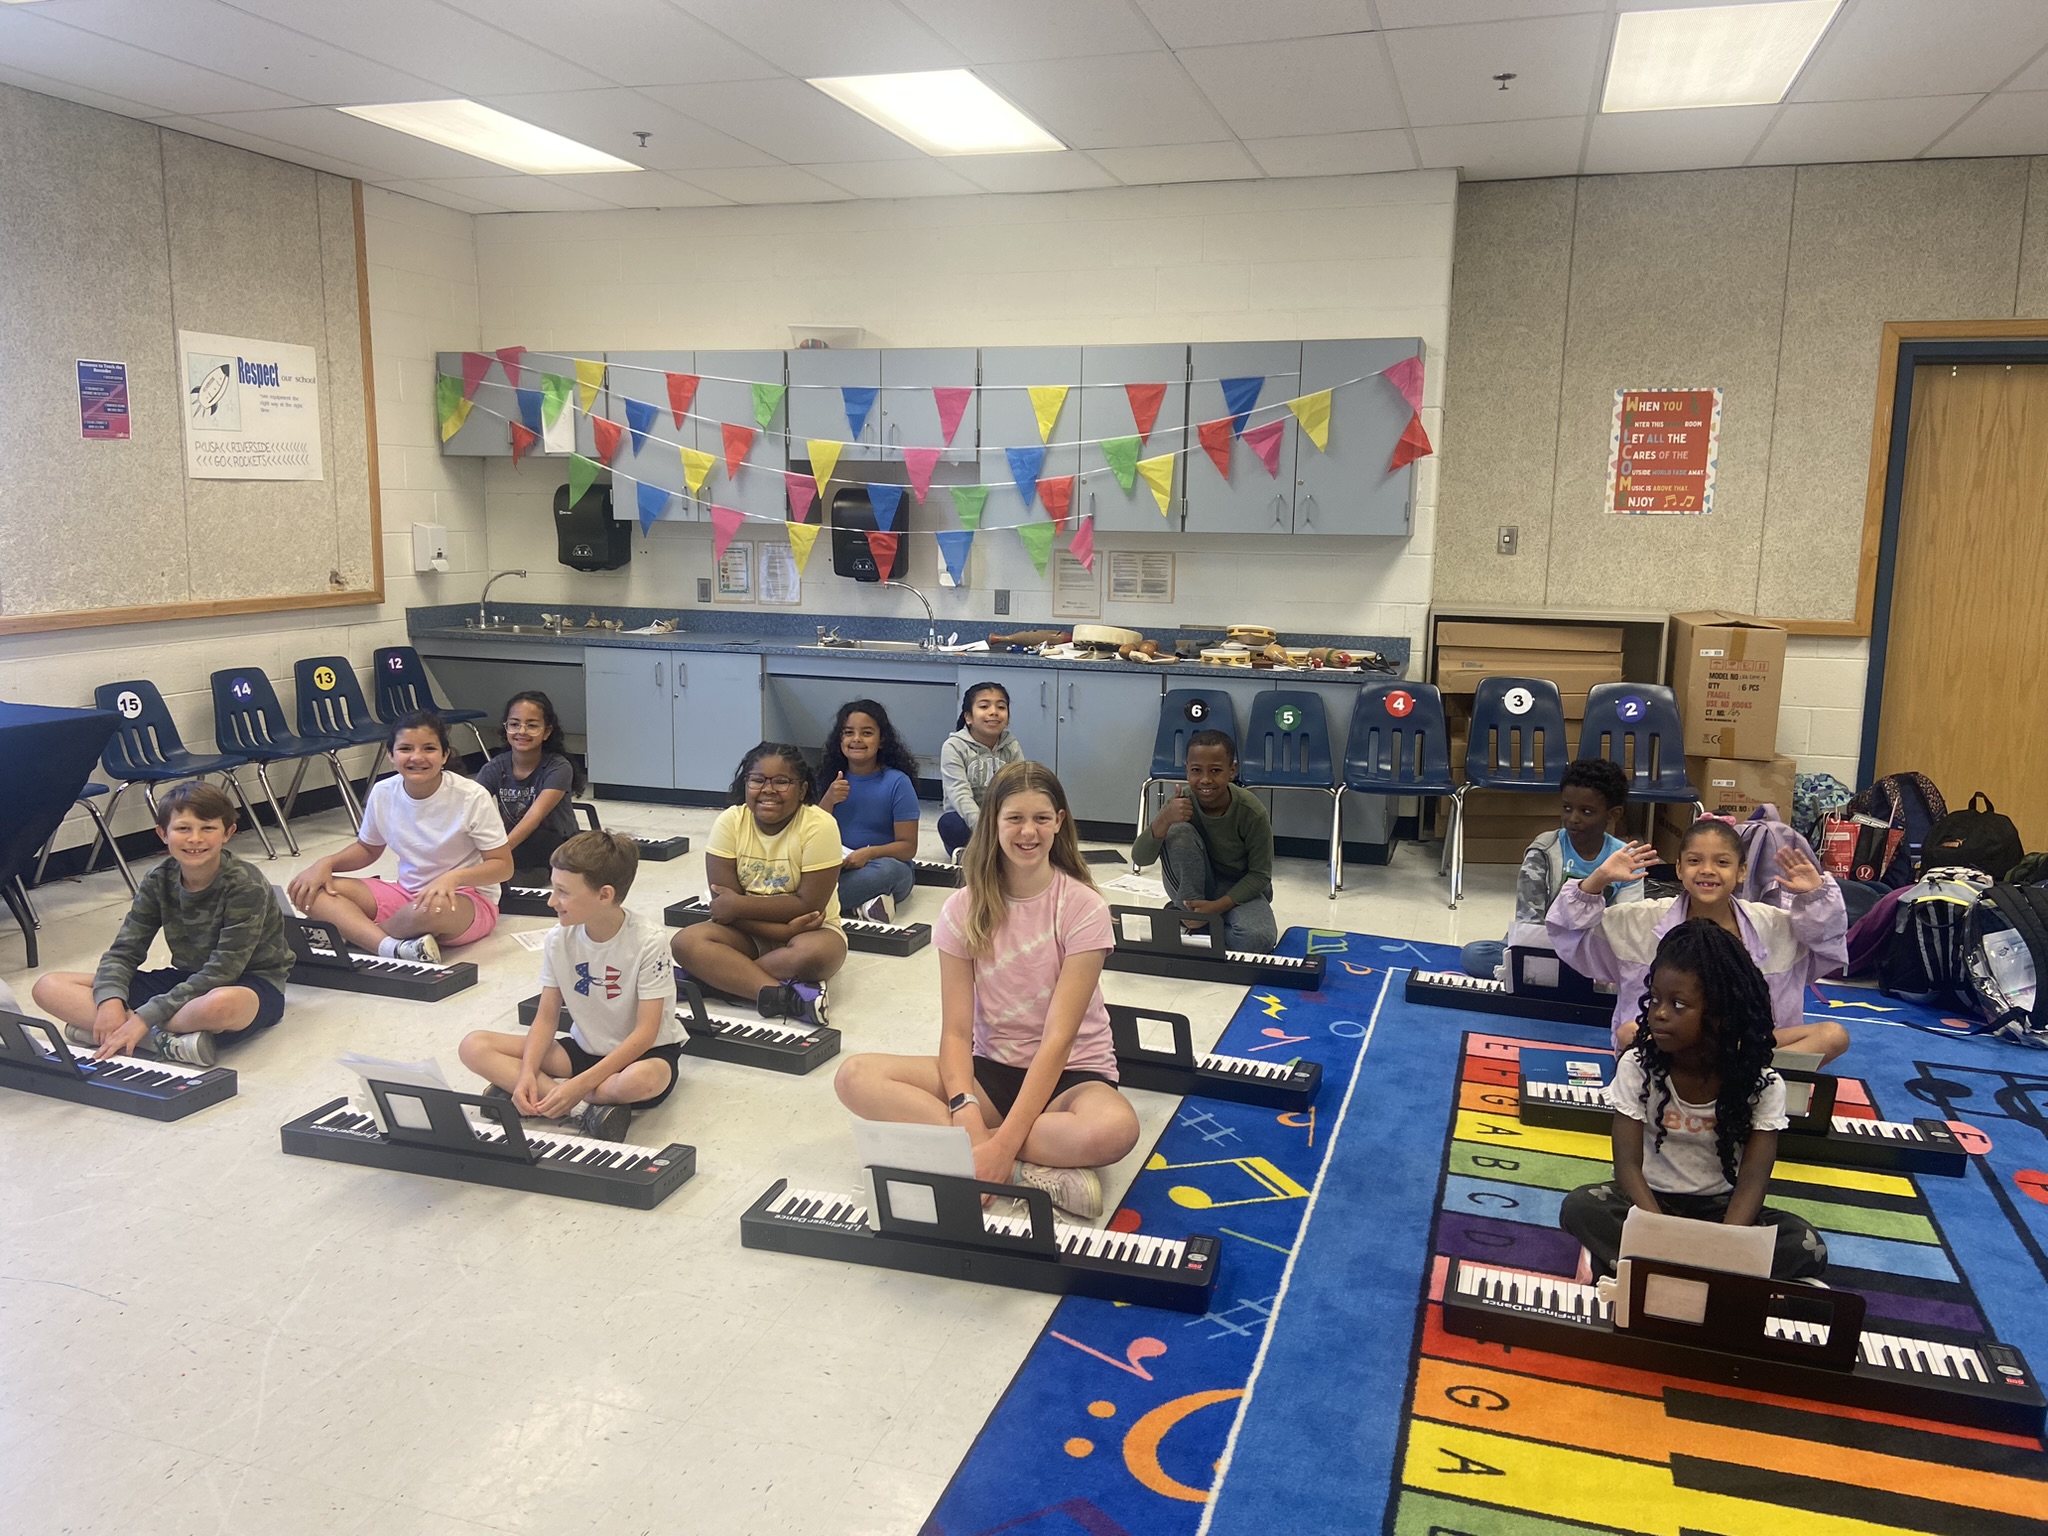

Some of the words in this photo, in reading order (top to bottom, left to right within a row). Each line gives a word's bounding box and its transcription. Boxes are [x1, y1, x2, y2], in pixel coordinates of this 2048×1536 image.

[237, 356, 280, 388] Respect
[295, 375, 316, 384] school
[1626, 396, 1660, 412] WHEN
[1663, 401, 1683, 412] YOU
[1624, 429, 1644, 444] LET
[1646, 434, 1664, 444] ALL
[1668, 434, 1686, 444] THE
[1622, 444, 1656, 460] CARES
[1658, 451, 1670, 460] OF
[1672, 451, 1688, 460] THE
[1620, 476, 1644, 491] MUSIC
[388, 658, 403, 669] 12
[316, 672, 333, 684] 13
[1709, 672, 1728, 680] MODEL
[234, 682, 251, 698] 14
[1706, 691, 1730, 699] FRAGILE
[120, 698, 138, 711] 15
[1392, 697, 1405, 710] 4
[1513, 694, 1524, 707] 3
[1706, 700, 1718, 708] USE
[1720, 700, 1730, 708] NO
[1732, 701, 1752, 709] HOOKS
[1191, 704, 1202, 718] 6
[1624, 702, 1638, 716] 2
[1283, 711, 1294, 724] 5
[1718, 804, 1738, 812] MODEL
[1476, 1122, 1522, 1136] A
[1472, 1155, 1520, 1171] B
[1467, 1192, 1520, 1208] C
[774, 1214, 808, 1223] Dance
[807, 1218, 841, 1228] Finger
[1464, 1230, 1517, 1248] D
[1482, 1298, 1522, 1311] Dance
[1524, 1306, 1566, 1319] Finger
[1444, 1385, 1510, 1411] G
[1436, 1447, 1507, 1476] A
